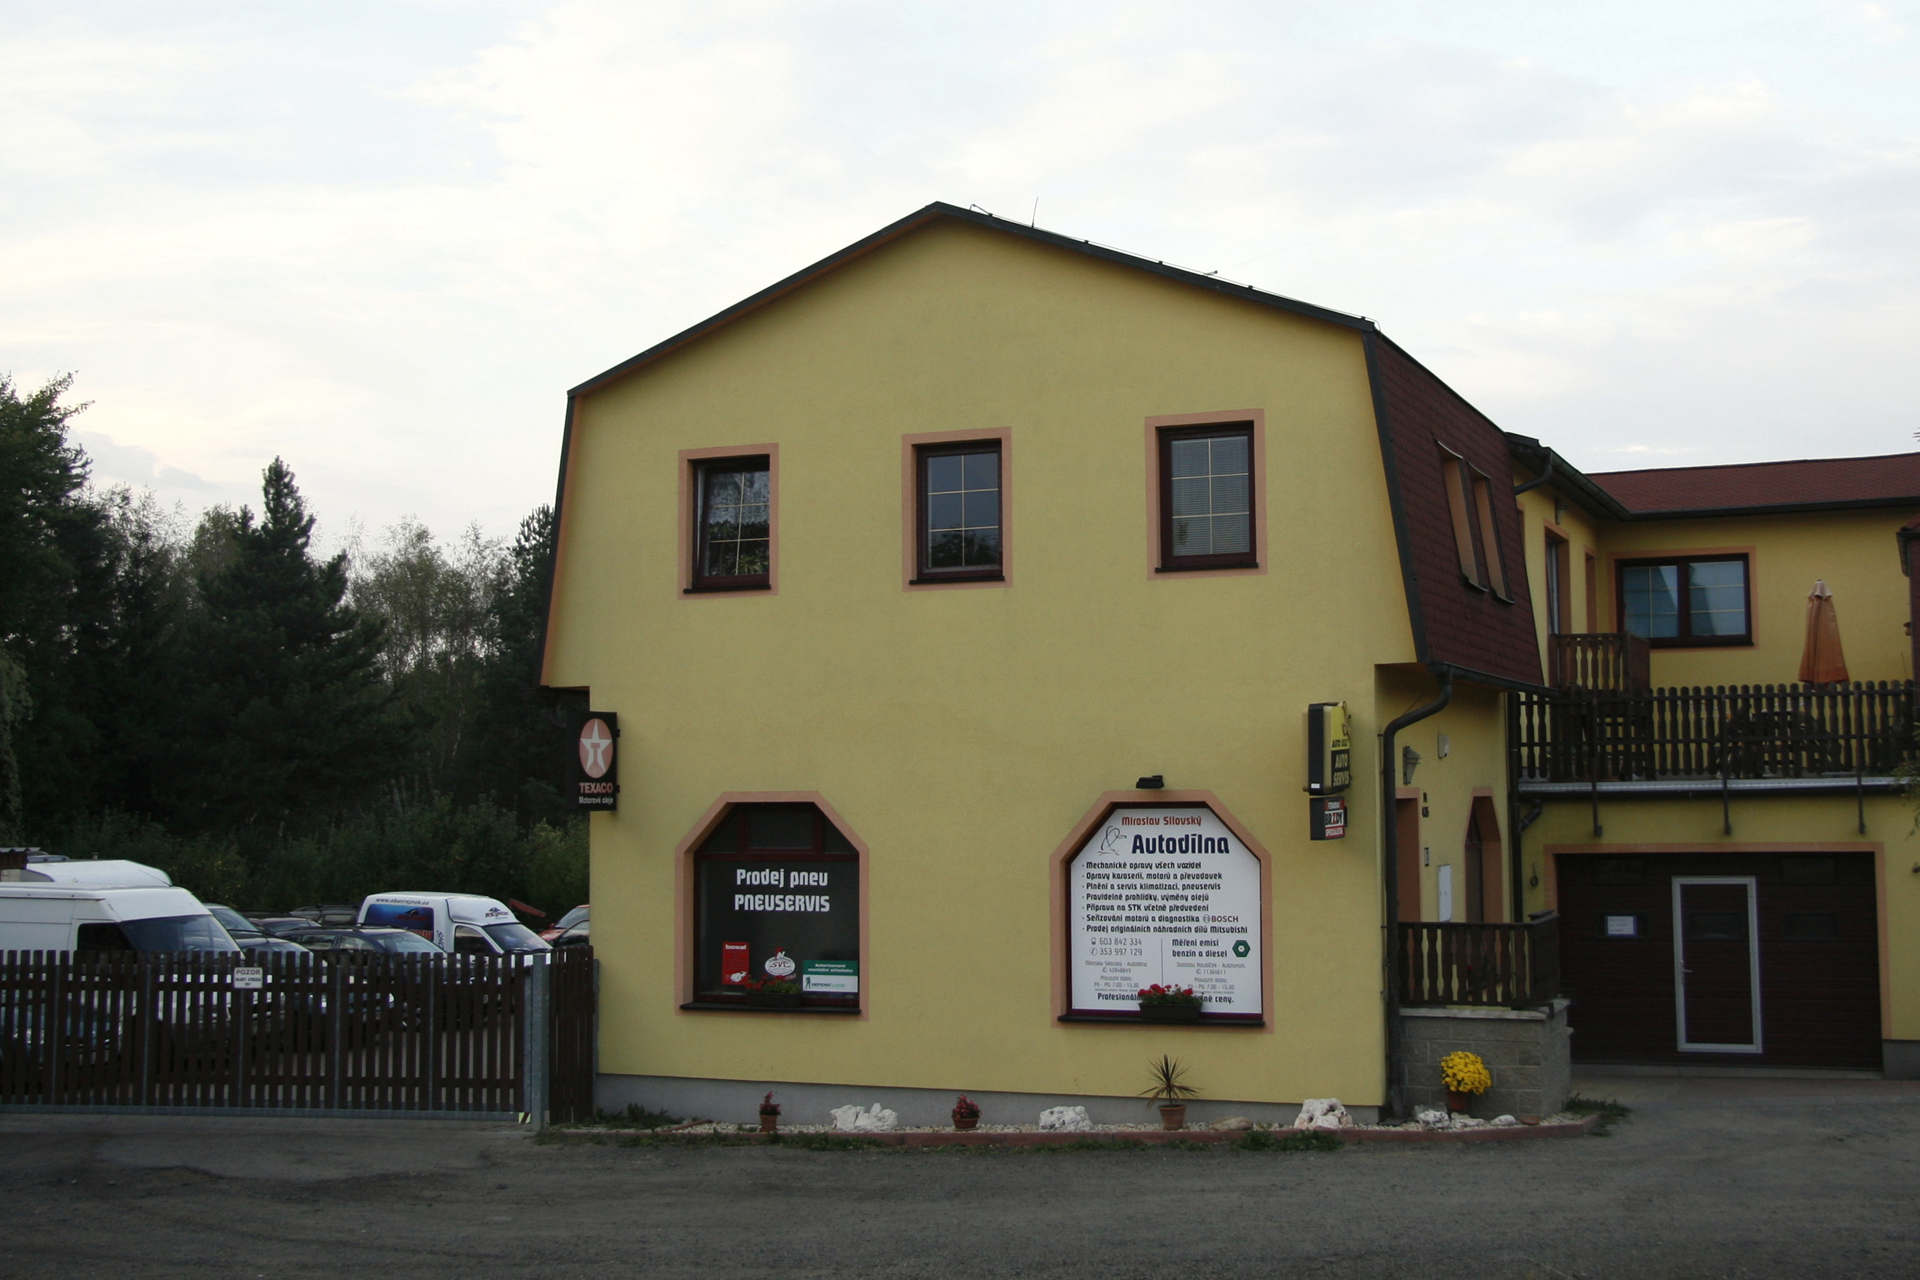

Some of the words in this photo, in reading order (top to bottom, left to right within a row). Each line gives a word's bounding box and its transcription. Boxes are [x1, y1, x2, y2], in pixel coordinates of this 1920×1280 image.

[1335, 753, 1348, 768] AUTO
[1333, 771, 1349, 786] SERVIS
[579, 782, 613, 793] TEXACO
[1122, 817, 1160, 825] Miroslav
[1164, 816, 1202, 826] Silovský
[1131, 834, 1229, 854] Autodílna
[1086, 861, 1127, 869] Mechanické
[1130, 862, 1152, 870] opravy
[1155, 861, 1175, 869] všech
[1177, 861, 1201, 869] vozidel
[736, 869, 784, 888] Prodej
[790, 871, 828, 888] pneu
[1086, 872, 1110, 880] Opravy
[1146, 872, 1170, 880] motorů
[1180, 872, 1222, 880] převodovek
[1086, 882, 1108, 890] Plnění
[1182, 883, 1221, 891] pneuservis
[1086, 893, 1123, 901] Pravidelné
[1161, 893, 1188, 902] výměny
[1191, 894, 1209, 902] olejů
[734, 894, 830, 912] PNEUSERVIS
[1086, 904, 1114, 912] Příprava
[1144, 904, 1167, 912] včetně
[1169, 904, 1209, 912] předvedení
[1086, 914, 1122, 922] Seřizování
[1158, 915, 1200, 923] diagnostika
[1086, 925, 1108, 933] Prodej
[1111, 925, 1151, 934] originálních
[1153, 926, 1192, 934] náhradních
[1210, 926, 1247, 934] Mitsubishi
[1130, 948, 1142, 956] 129
[1215, 996, 1234, 1004] ceny.
